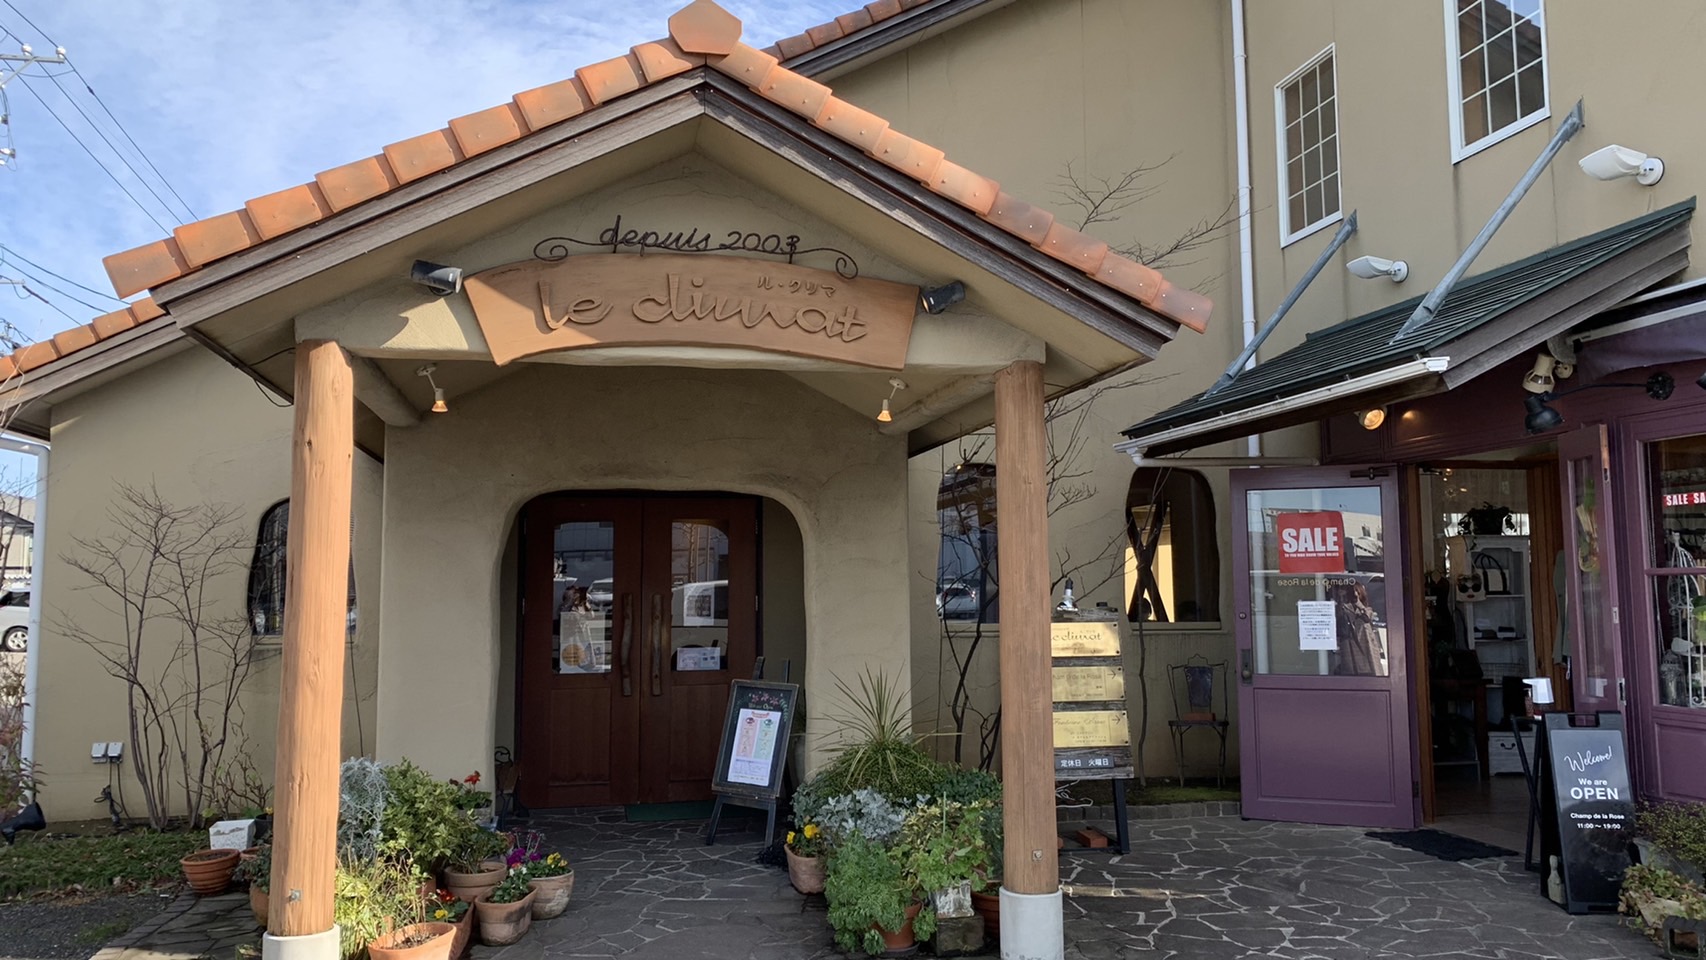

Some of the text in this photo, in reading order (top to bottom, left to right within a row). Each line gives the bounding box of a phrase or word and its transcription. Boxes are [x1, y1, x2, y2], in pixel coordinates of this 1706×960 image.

[599, 214, 801, 257] depuis 2003
[757, 275, 837, 298] ル・クリマ
[537, 272, 868, 343] le climat
[1665, 494, 1689, 506] SALE
[1282, 527, 1339, 553] SALE
[1060, 758, 1109, 768] 定休日 火曜日
[1578, 778, 1592, 786] We
[1570, 787, 1619, 800] OPEN
[1570, 812, 1592, 820] Champ
